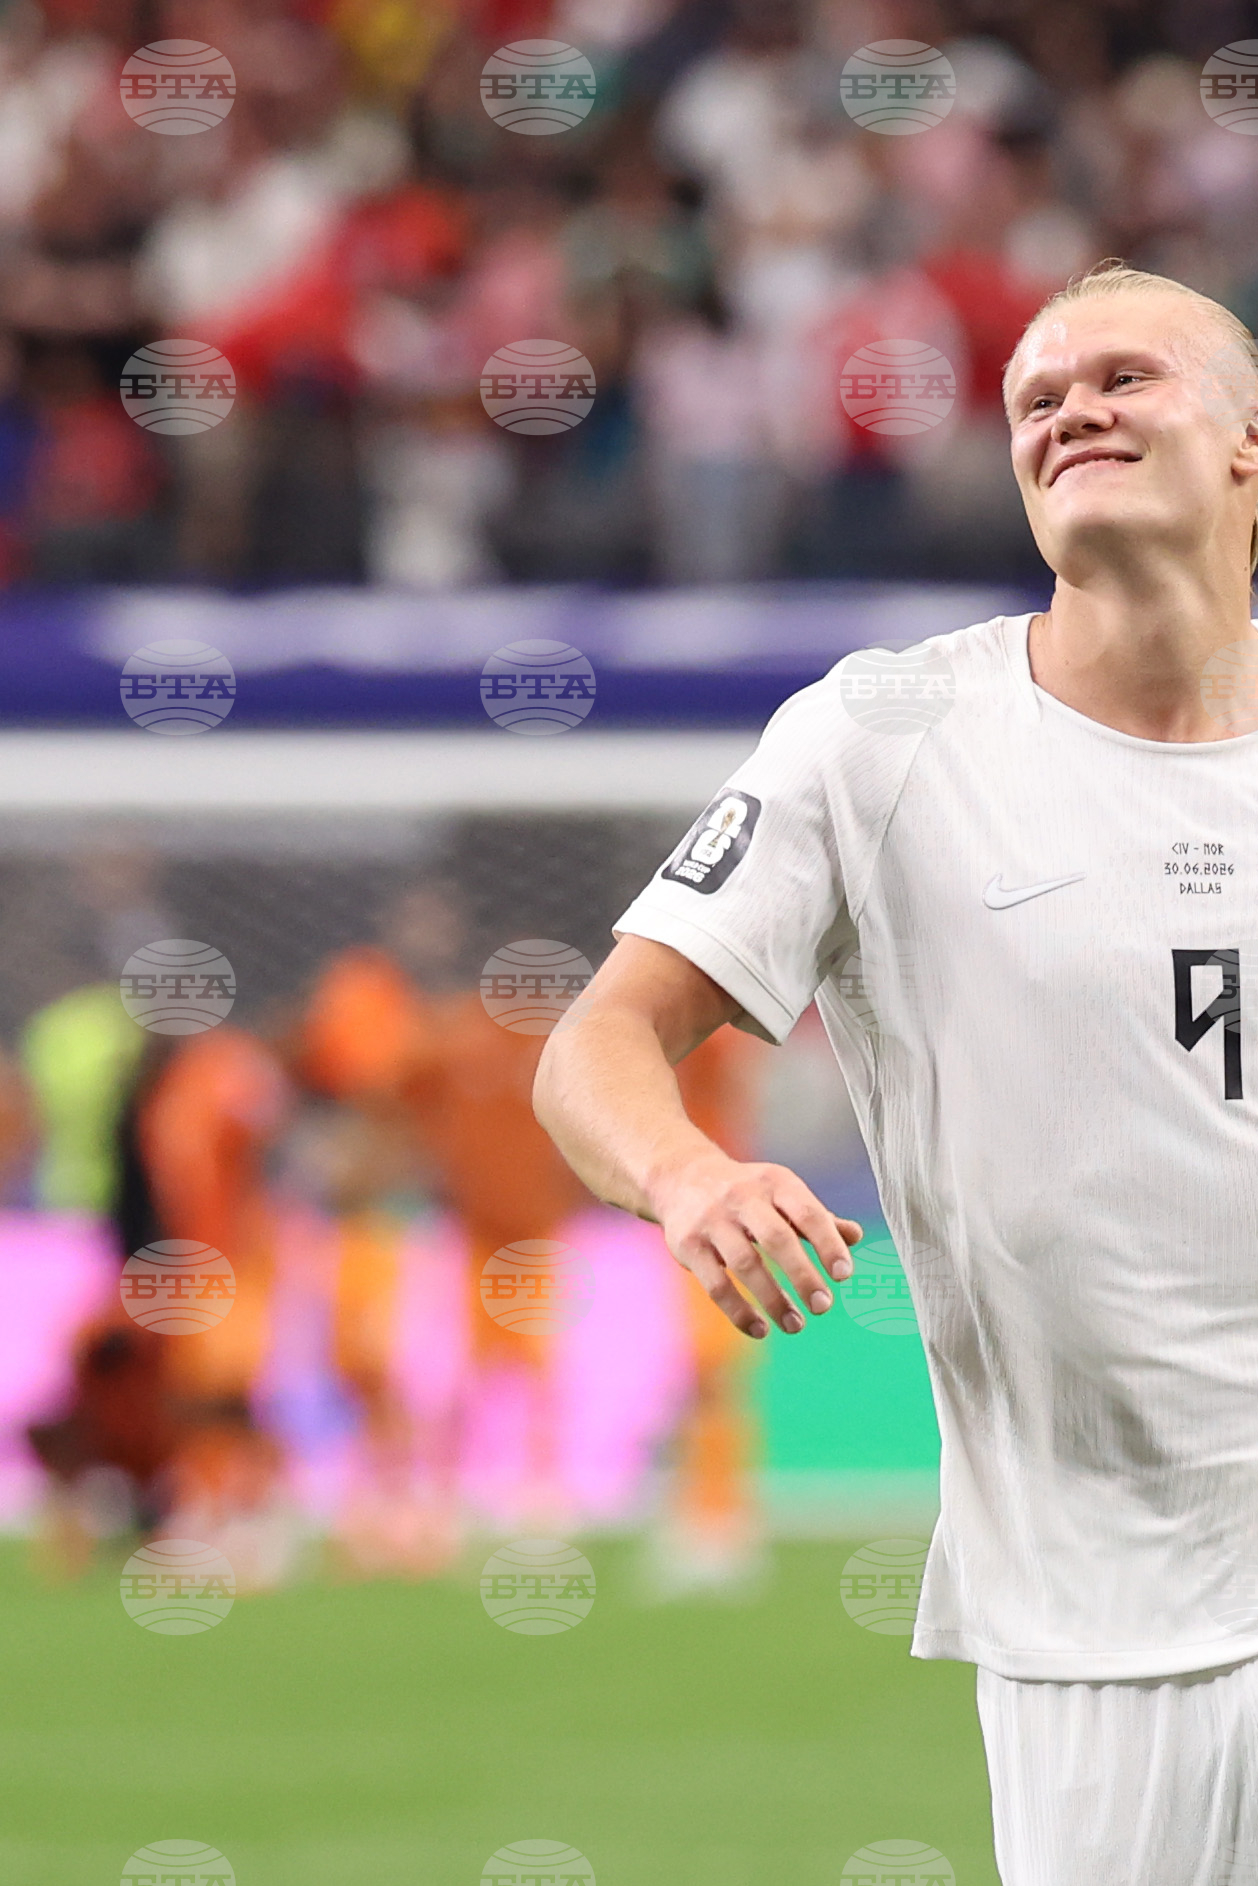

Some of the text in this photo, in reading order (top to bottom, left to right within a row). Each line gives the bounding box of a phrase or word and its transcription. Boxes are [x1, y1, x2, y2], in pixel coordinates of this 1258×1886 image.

[1171, 842, 1189, 855] CIV
[1203, 843, 1225, 856] NOR
[1163, 862, 1236, 876] 30.06.2026
[1179, 882, 1223, 895] DALLAS
[1171, 948, 1244, 1100] 9
